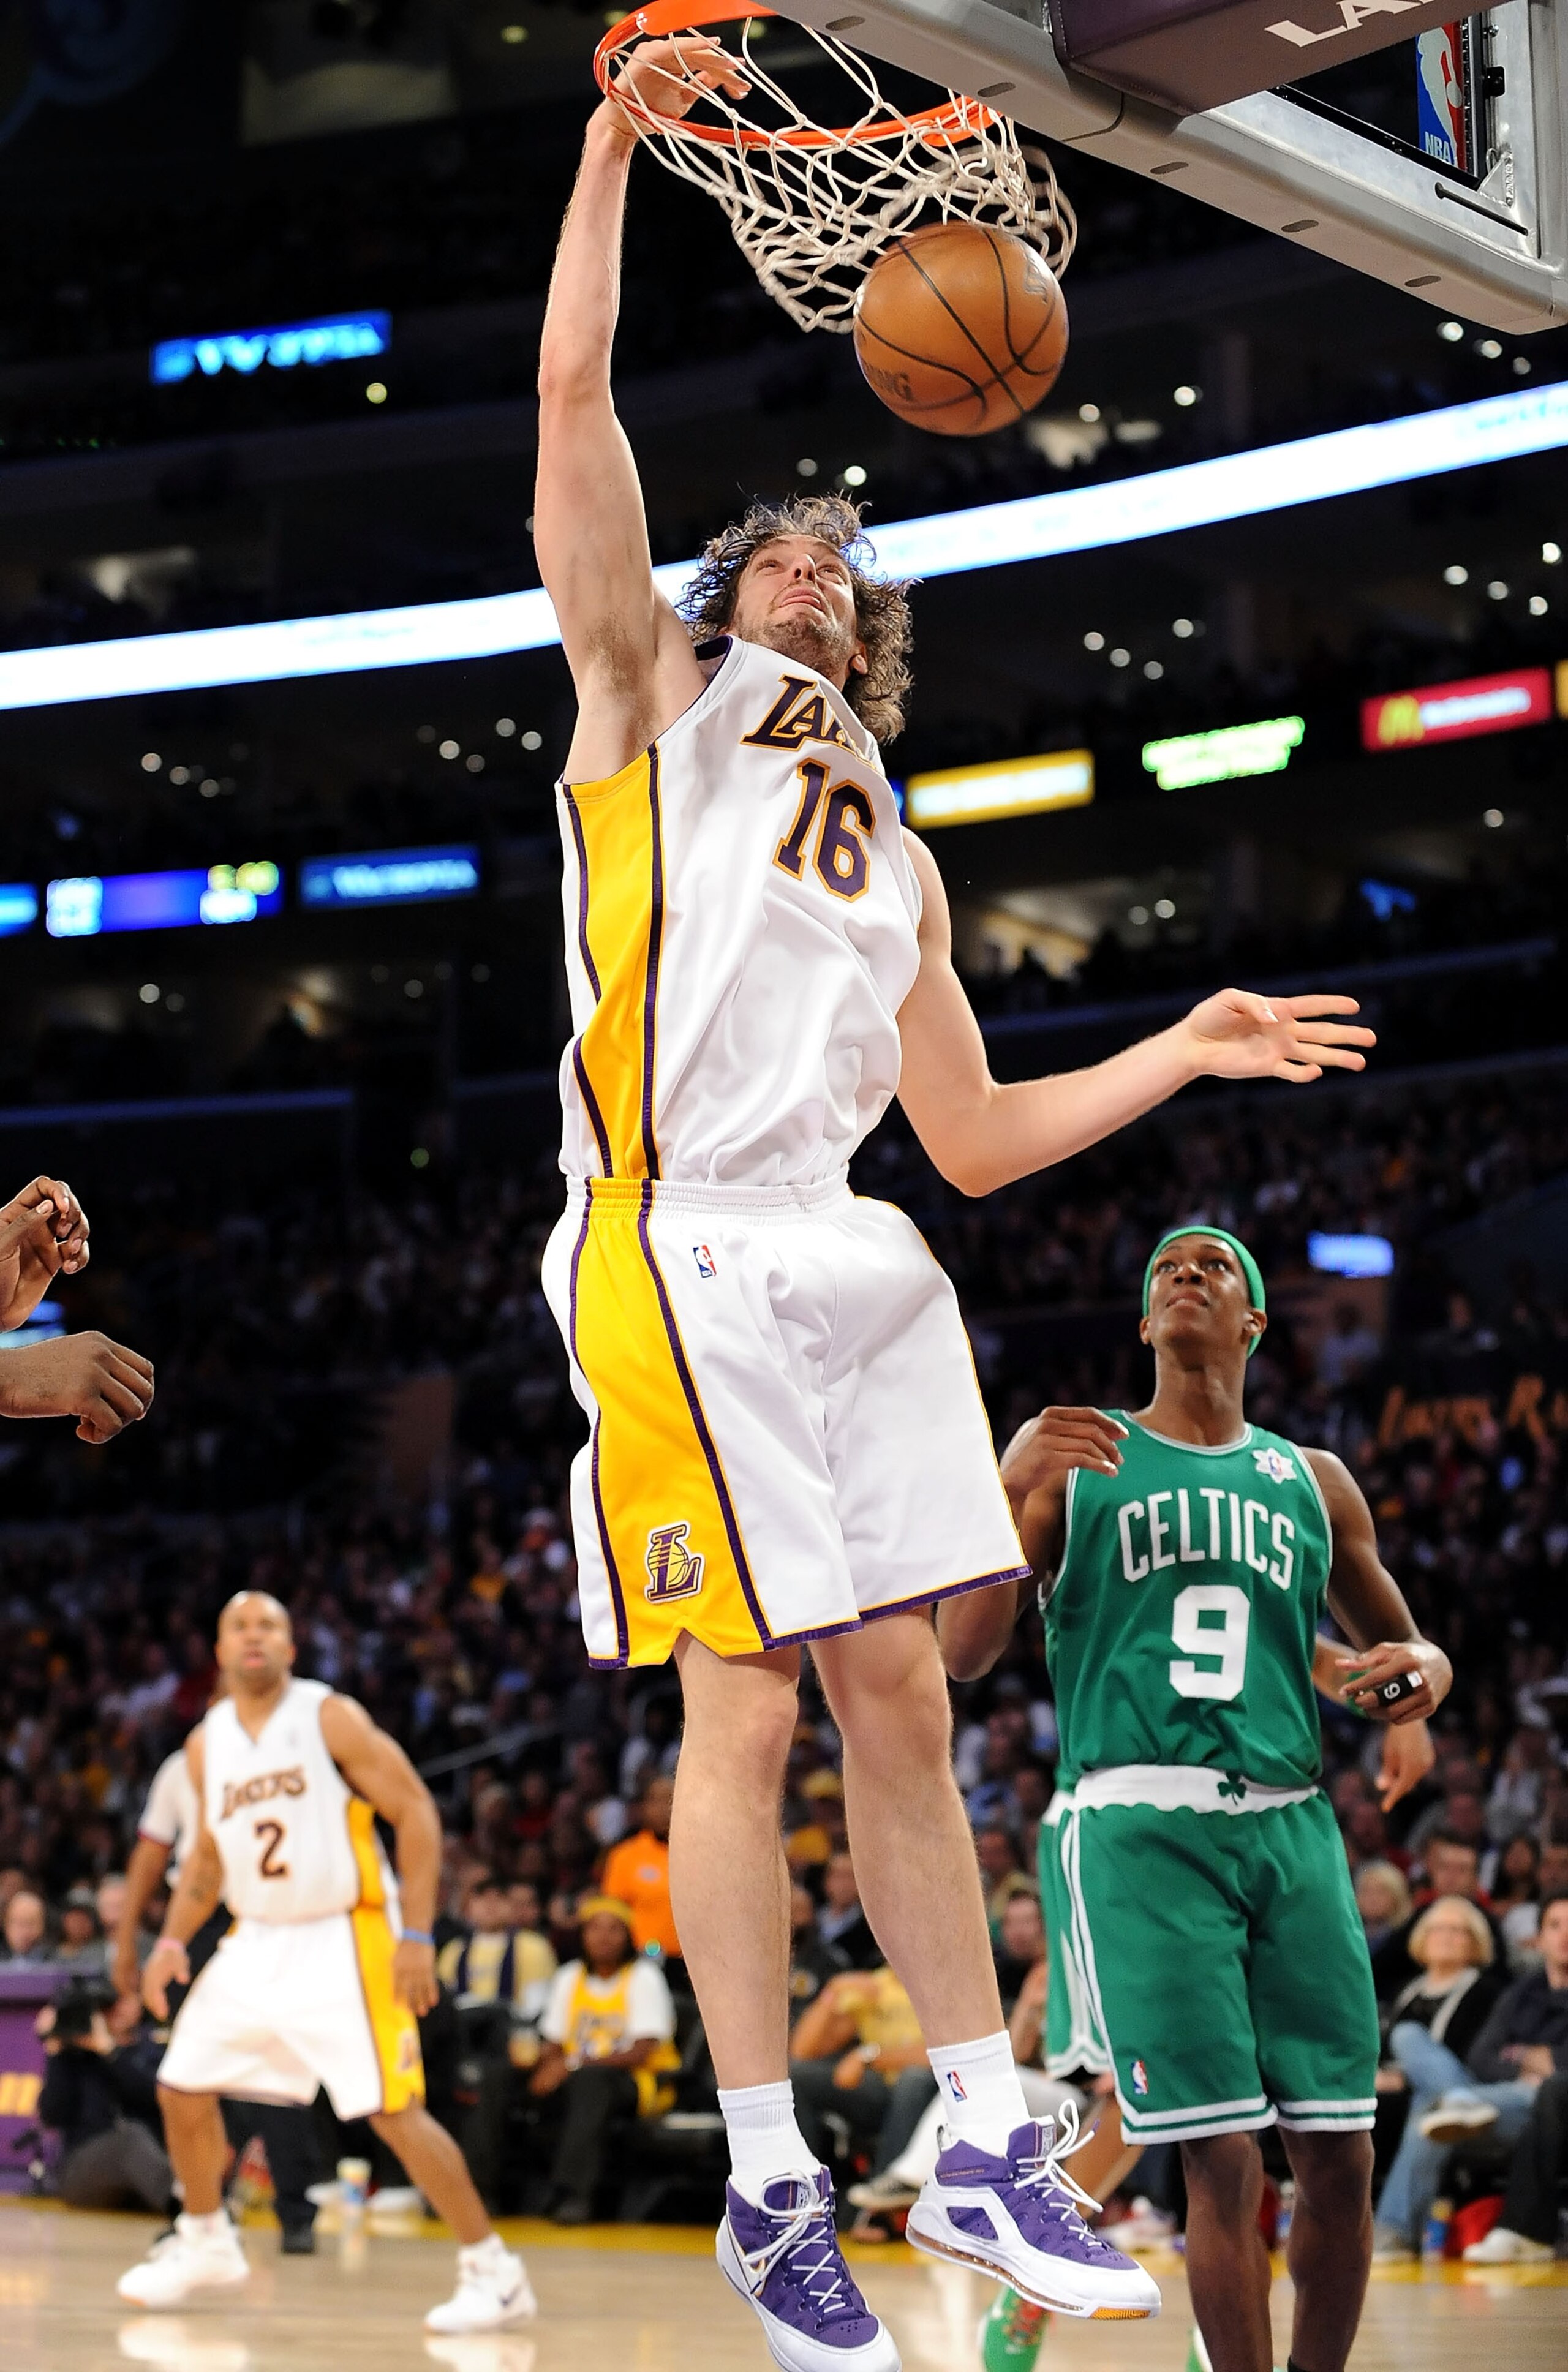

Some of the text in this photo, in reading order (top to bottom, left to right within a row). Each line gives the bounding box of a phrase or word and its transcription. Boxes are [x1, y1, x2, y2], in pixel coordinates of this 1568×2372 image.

[1425, 130, 1452, 164] NBA
[772, 757, 876, 903] 16
[1117, 1488, 1295, 1591] CELTICS
[1169, 1585, 1251, 1701] 9
[255, 1819, 289, 1880] 2
